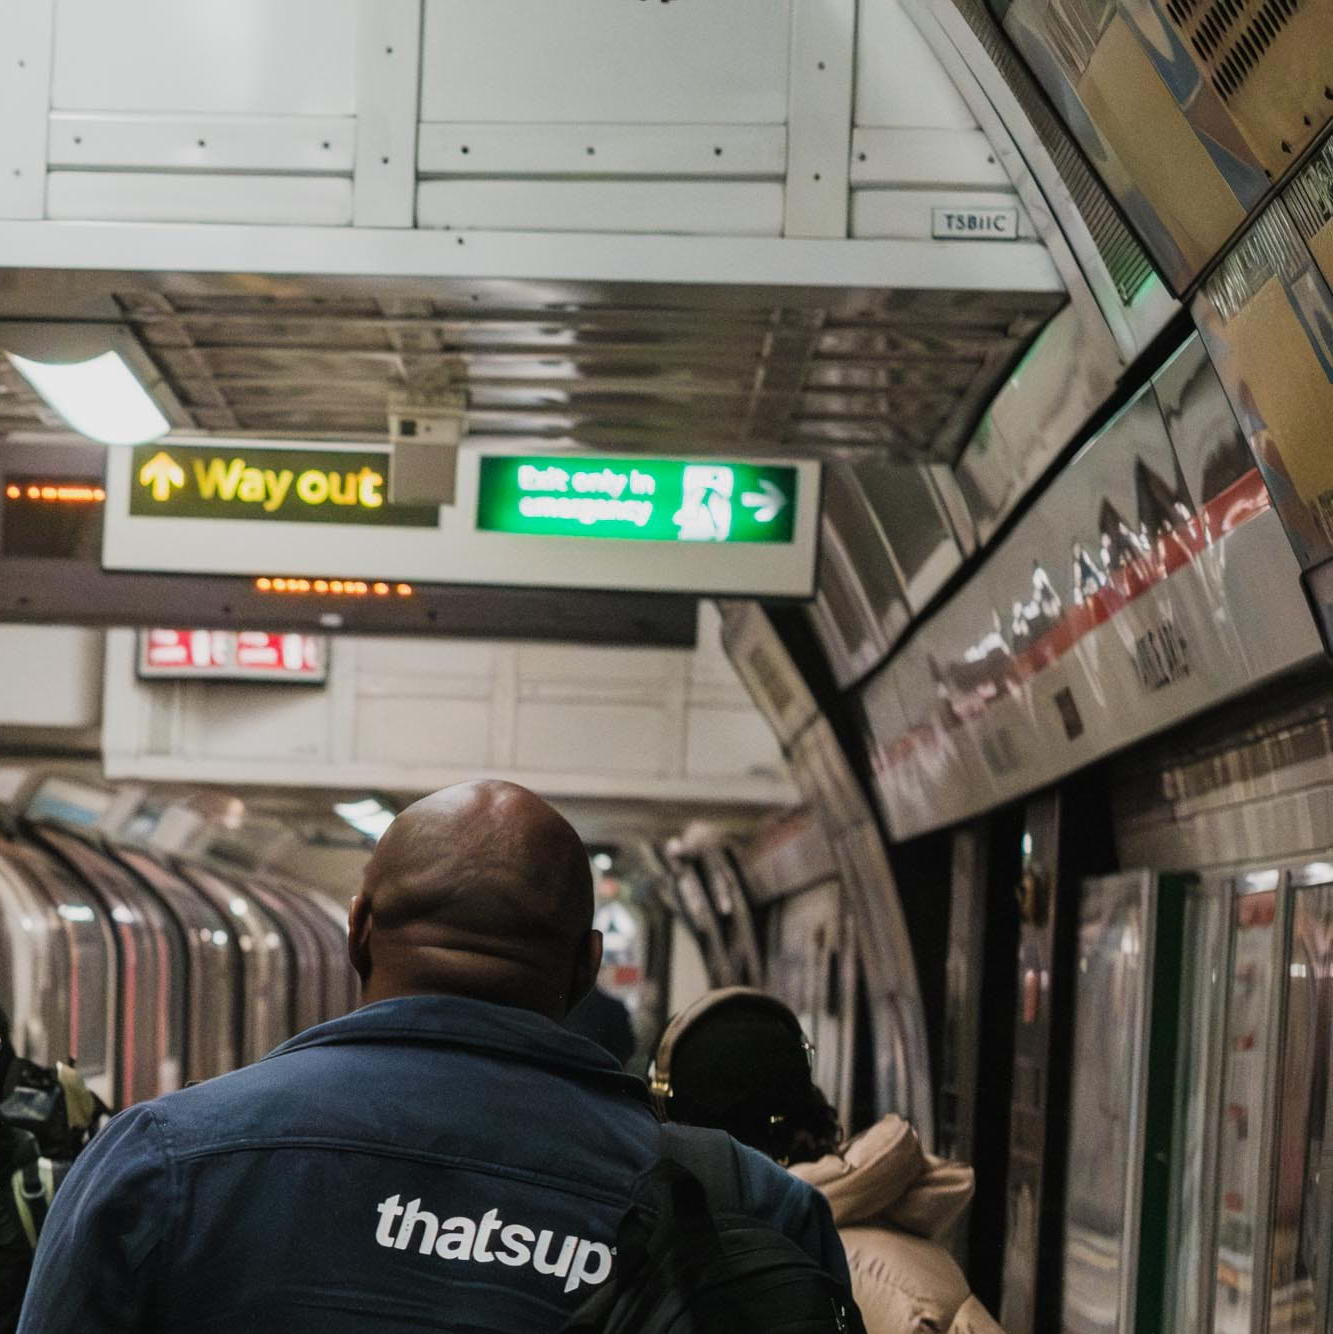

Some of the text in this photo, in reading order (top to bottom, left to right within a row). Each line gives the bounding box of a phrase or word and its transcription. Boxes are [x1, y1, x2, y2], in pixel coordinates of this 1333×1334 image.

[192, 457, 383, 512] Way out
[518, 465, 655, 499] Exit only in
[519, 496, 652, 526] emergency
[376, 1194, 613, 1293] thatsup
